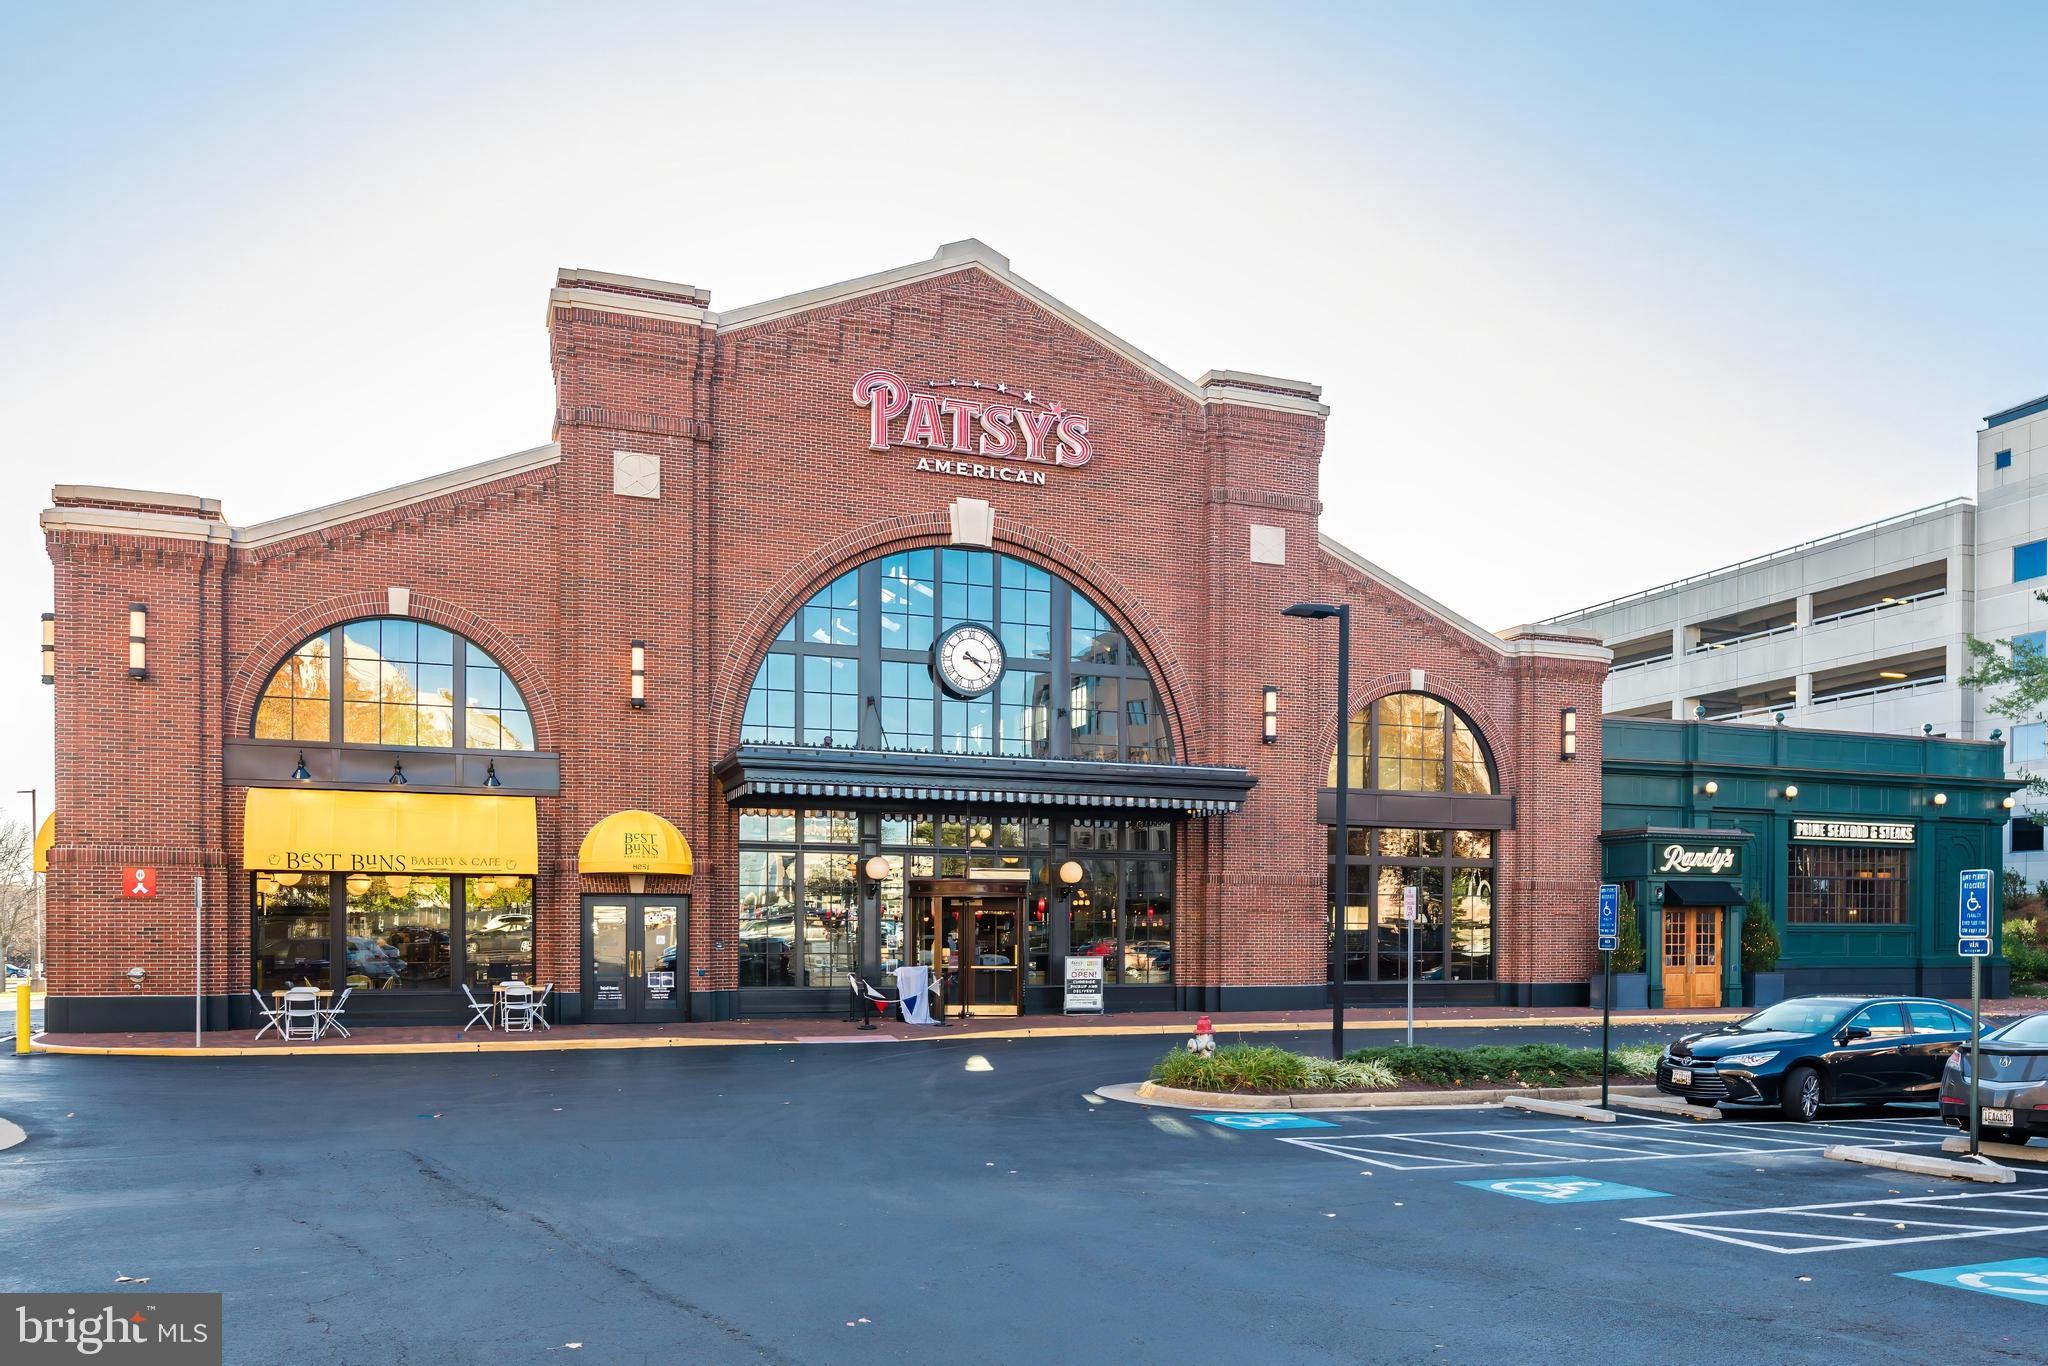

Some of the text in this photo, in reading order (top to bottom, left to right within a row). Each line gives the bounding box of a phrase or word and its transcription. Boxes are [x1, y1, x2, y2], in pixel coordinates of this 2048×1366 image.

[916, 458, 1046, 486] AMERICAN
[1796, 823, 1826, 837] PRIME
[1827, 824, 1869, 838] SEAFOOD
[1879, 826, 1913, 840] STEAKS
[411, 856, 456, 867] BAKERY
[459, 857, 468, 866] &
[1660, 844, 1735, 873] Randy's
